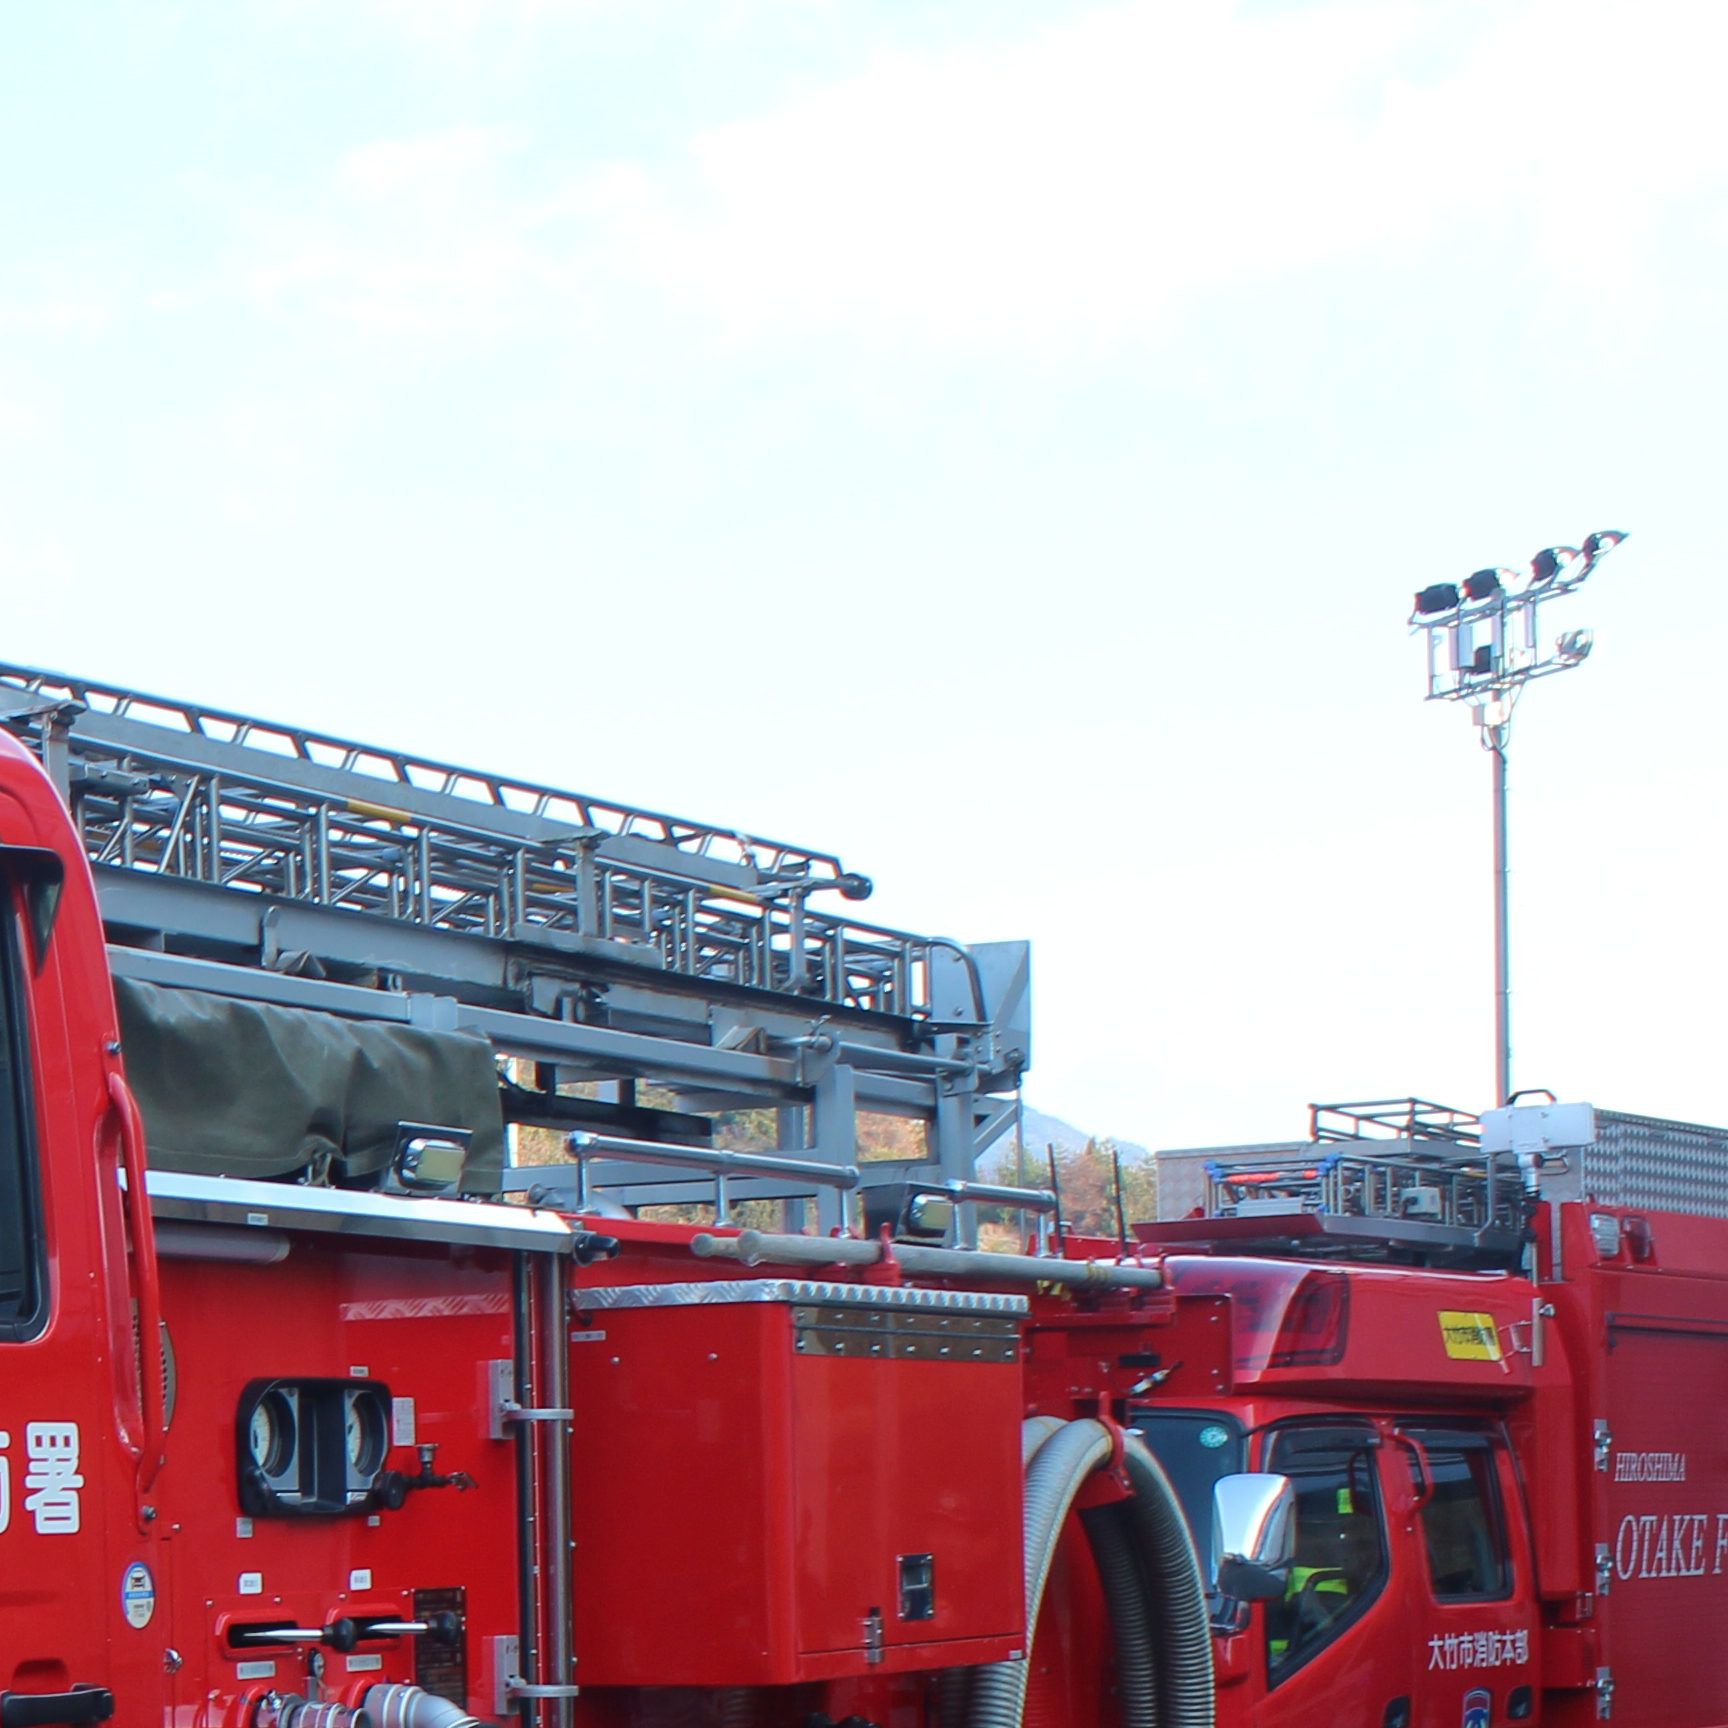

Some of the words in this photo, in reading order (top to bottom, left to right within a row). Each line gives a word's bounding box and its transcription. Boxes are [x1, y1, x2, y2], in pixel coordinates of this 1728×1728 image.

[1614, 1452, 1686, 1482] HIROSHIMA
[1616, 1514, 1708, 1580] OTAKE
[1428, 1629, 1529, 1670] 大竹市消防本部
